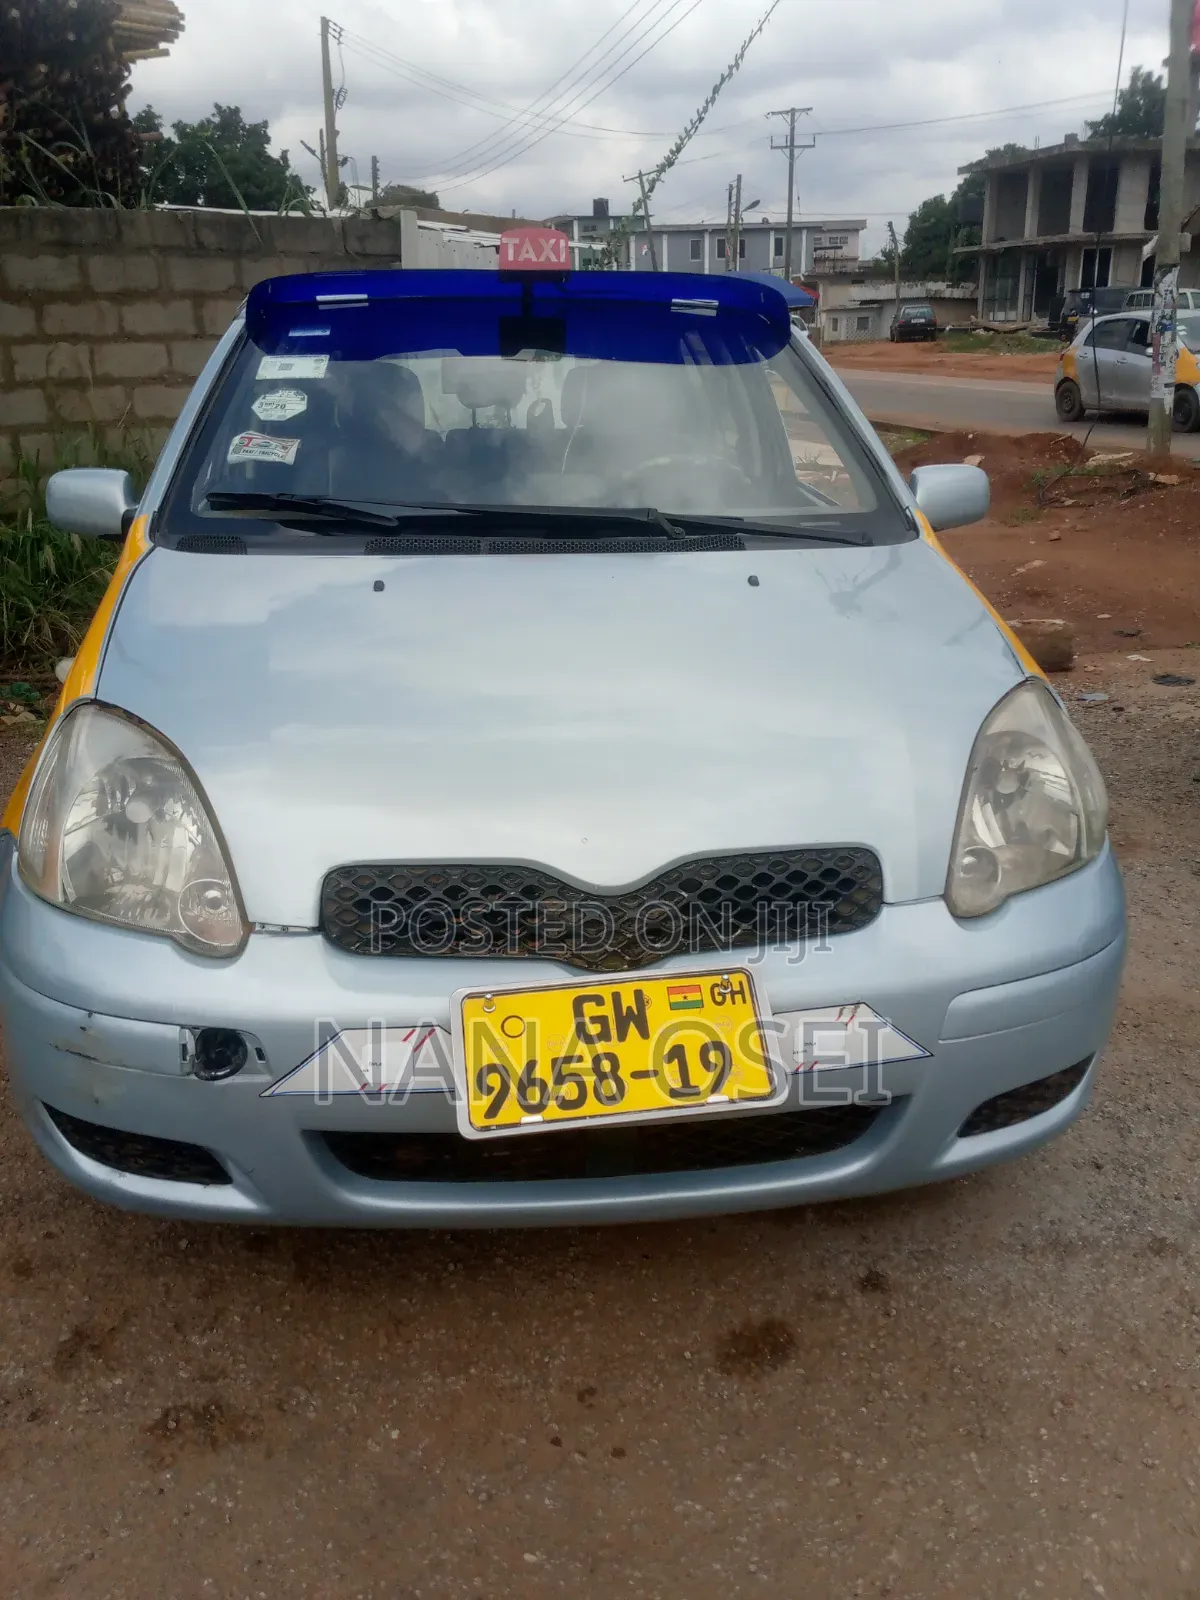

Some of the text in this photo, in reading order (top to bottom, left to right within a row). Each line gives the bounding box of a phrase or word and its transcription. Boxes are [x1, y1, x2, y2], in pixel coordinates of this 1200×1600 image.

[502, 237, 567, 262] TAXI
[572, 980, 747, 1046] GW GH
[476, 1040, 734, 1119] 9658-19
